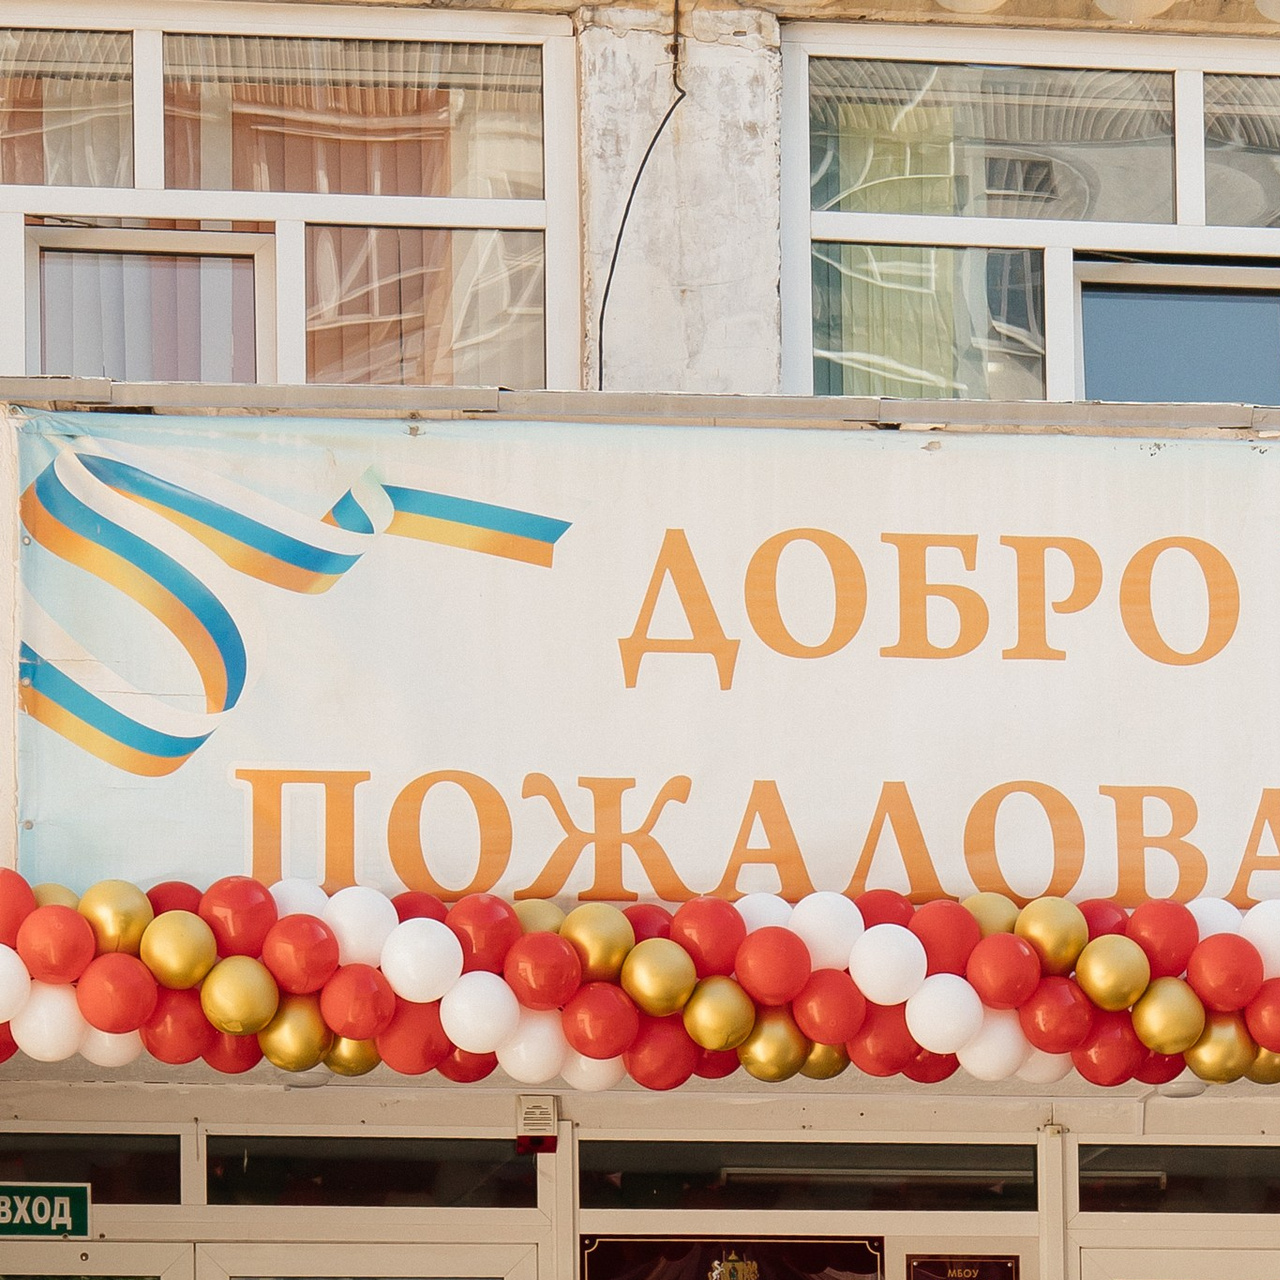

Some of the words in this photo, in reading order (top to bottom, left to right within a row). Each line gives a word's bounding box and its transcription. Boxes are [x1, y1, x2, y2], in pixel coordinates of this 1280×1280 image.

[617, 527, 1240, 691] ДОБРО
[0, 1195, 72, 1230] ВХОД
[947, 1269, 979, 1278] МБОУ
